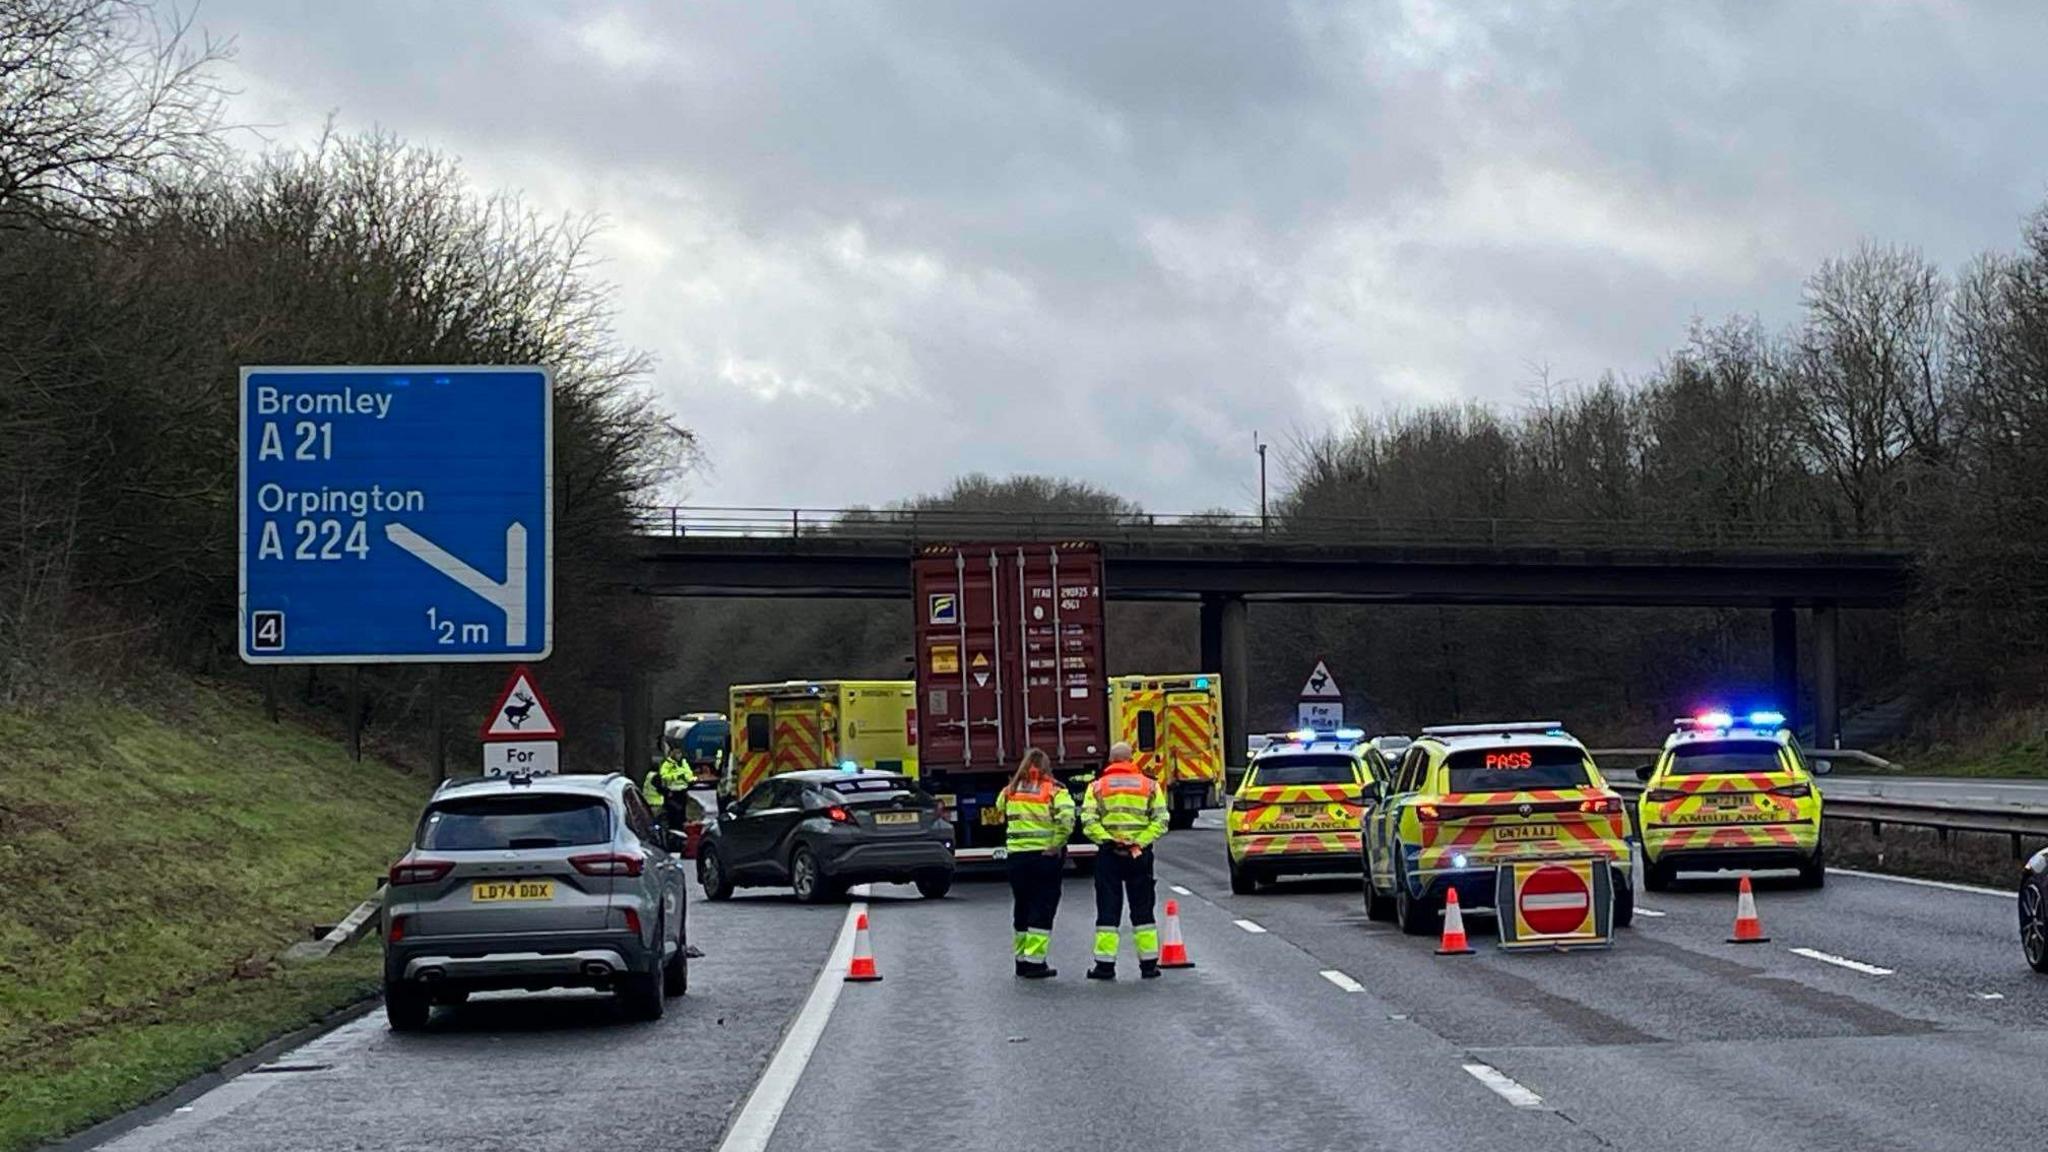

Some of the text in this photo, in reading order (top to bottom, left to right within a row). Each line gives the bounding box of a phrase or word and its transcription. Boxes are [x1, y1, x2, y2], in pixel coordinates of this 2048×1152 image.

[257, 387, 392, 418] Bromley
[258, 422, 332, 461] A 21
[257, 483, 424, 516] Orpington
[258, 520, 370, 560] A 224
[257, 618, 279, 643] 4
[462, 623, 488, 643] m
[1311, 706, 1328, 716] For
[506, 748, 535, 763] For
[1486, 752, 1532, 769] PASS
[1258, 821, 1349, 831] AMBULANCE
[1678, 813, 1777, 823] AMBULANCE
[478, 885, 516, 899] LD74
